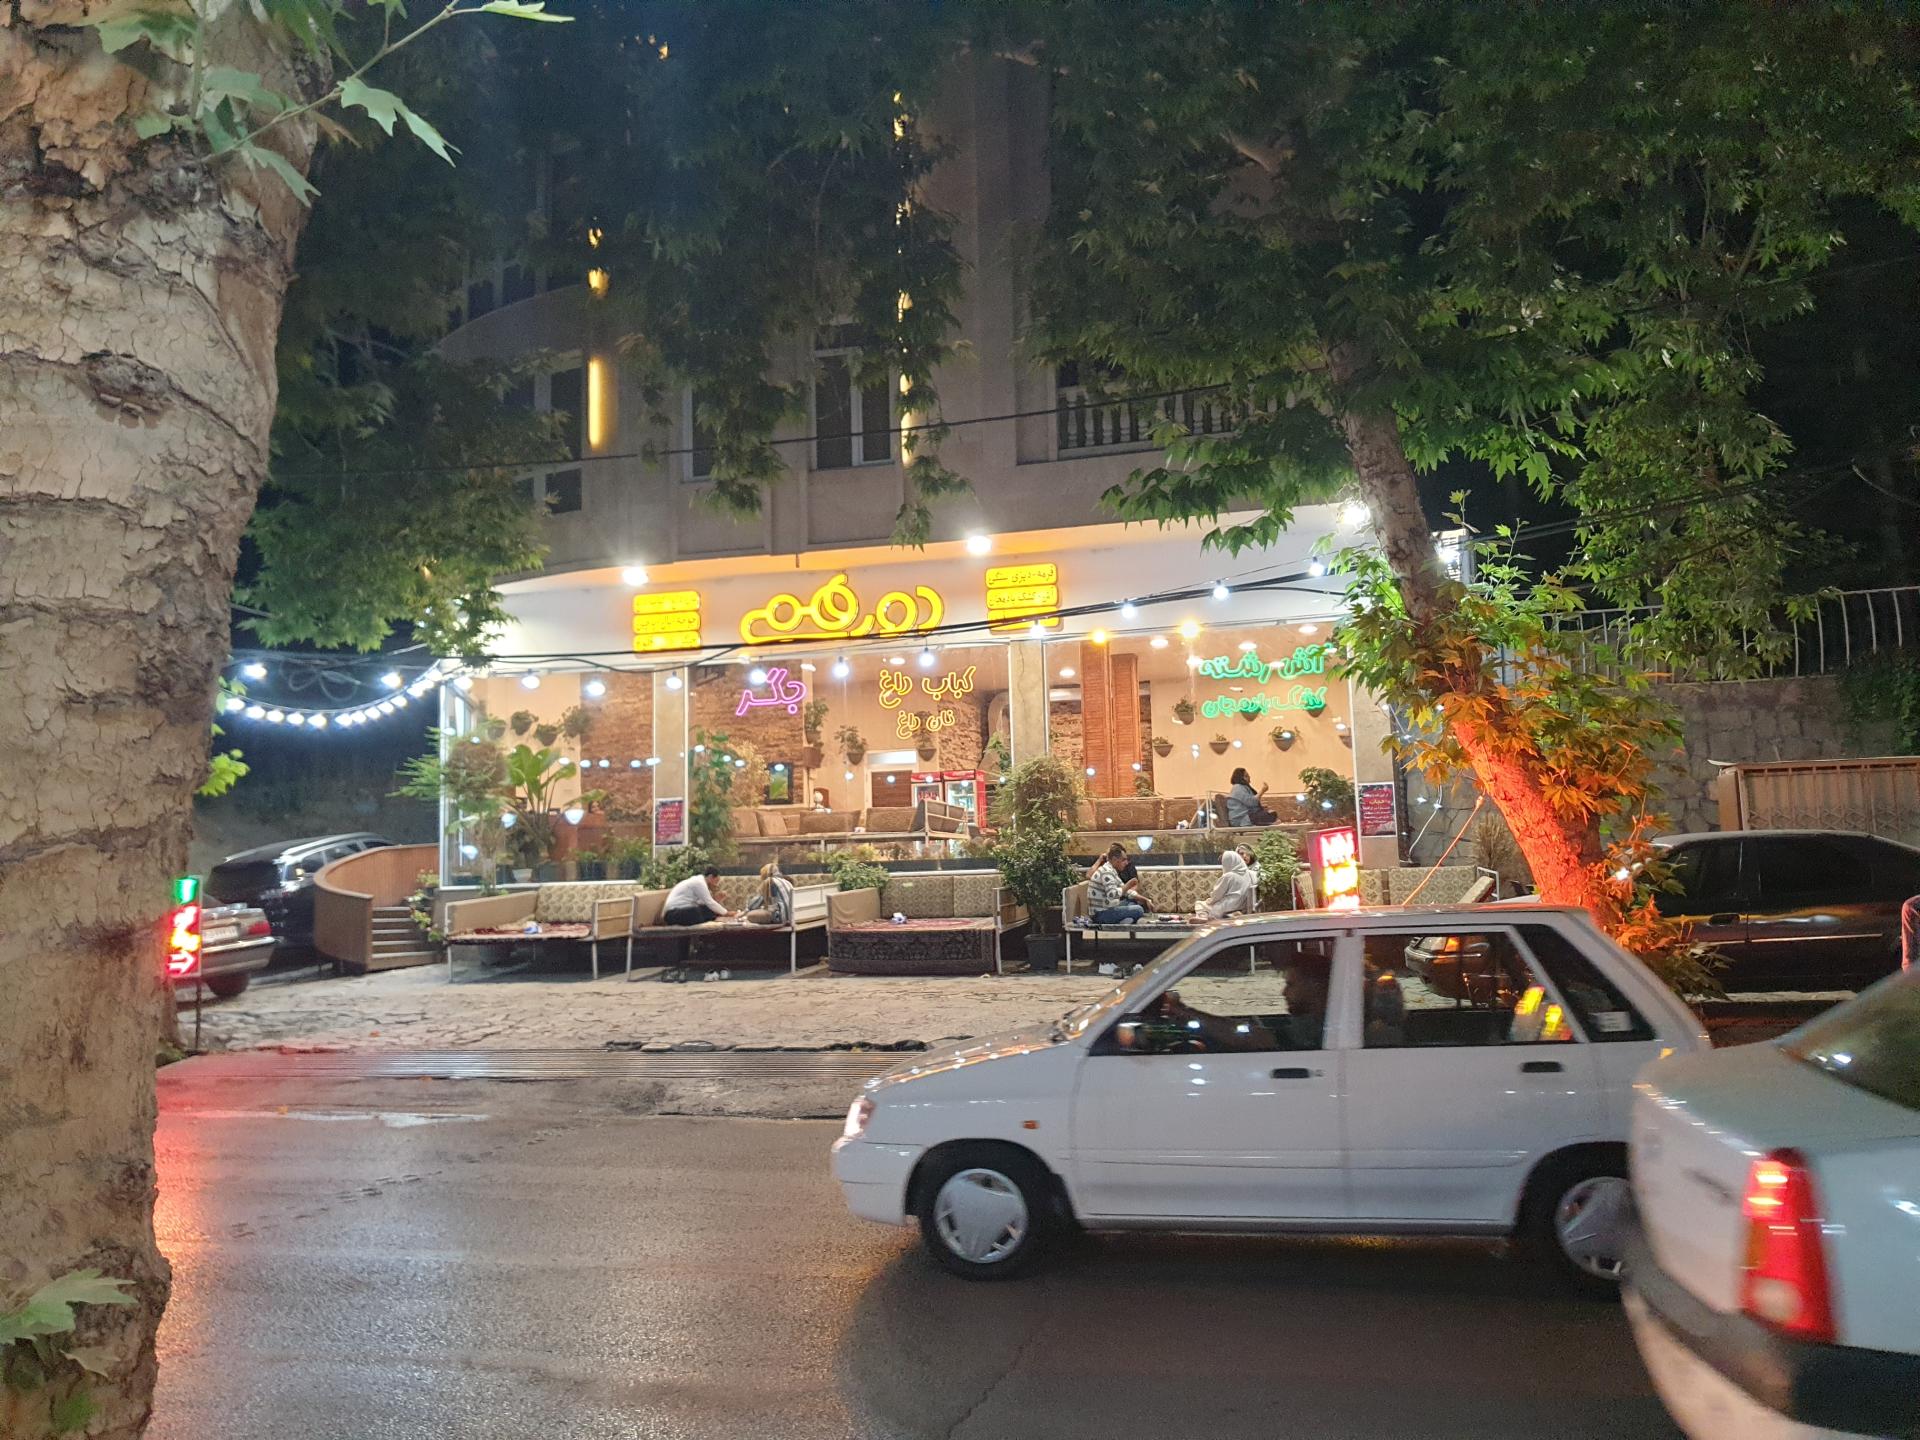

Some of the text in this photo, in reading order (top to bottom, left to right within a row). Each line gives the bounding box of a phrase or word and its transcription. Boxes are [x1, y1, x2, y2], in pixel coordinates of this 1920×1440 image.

[1198, 650, 1272, 684] رشته
[735, 667, 807, 716] جگر
[879, 665, 976, 709] کباب داغ
[896, 709, 955, 740] نان داغ
